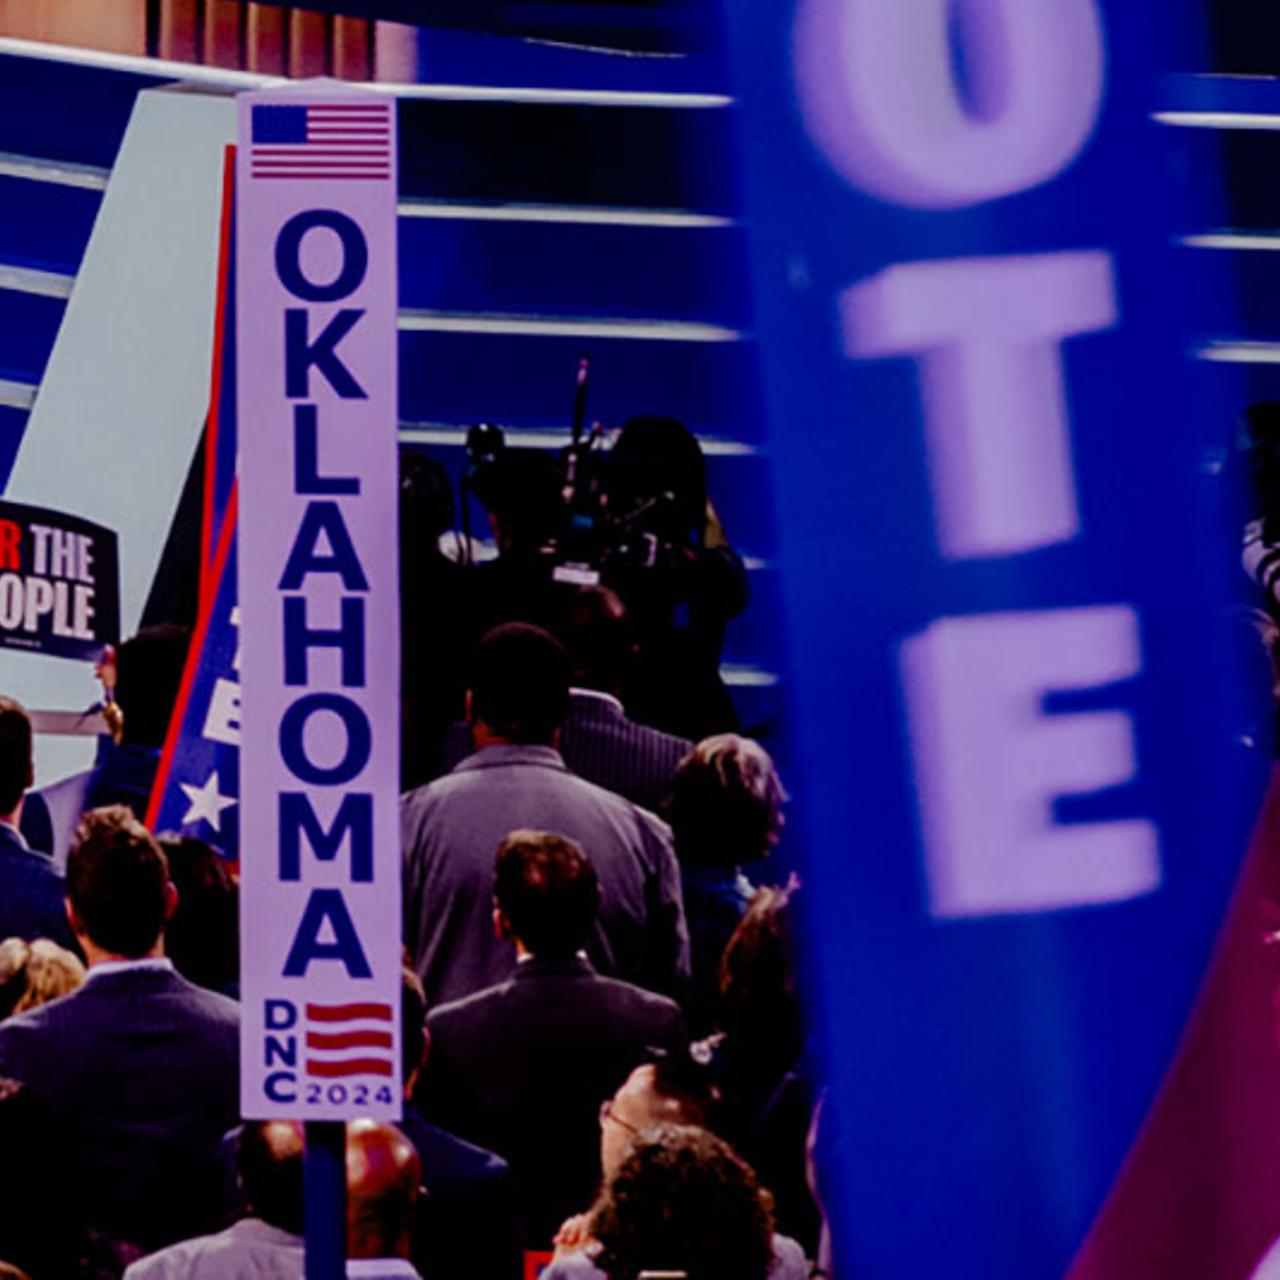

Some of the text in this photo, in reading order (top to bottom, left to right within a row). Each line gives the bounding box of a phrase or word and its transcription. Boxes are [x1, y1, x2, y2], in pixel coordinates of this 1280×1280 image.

[29, 523, 96, 585] THE
[273, 208, 376, 979] OKLAHOMA
[263, 998, 298, 1104] DNC
[305, 1083, 394, 1106] 2024
